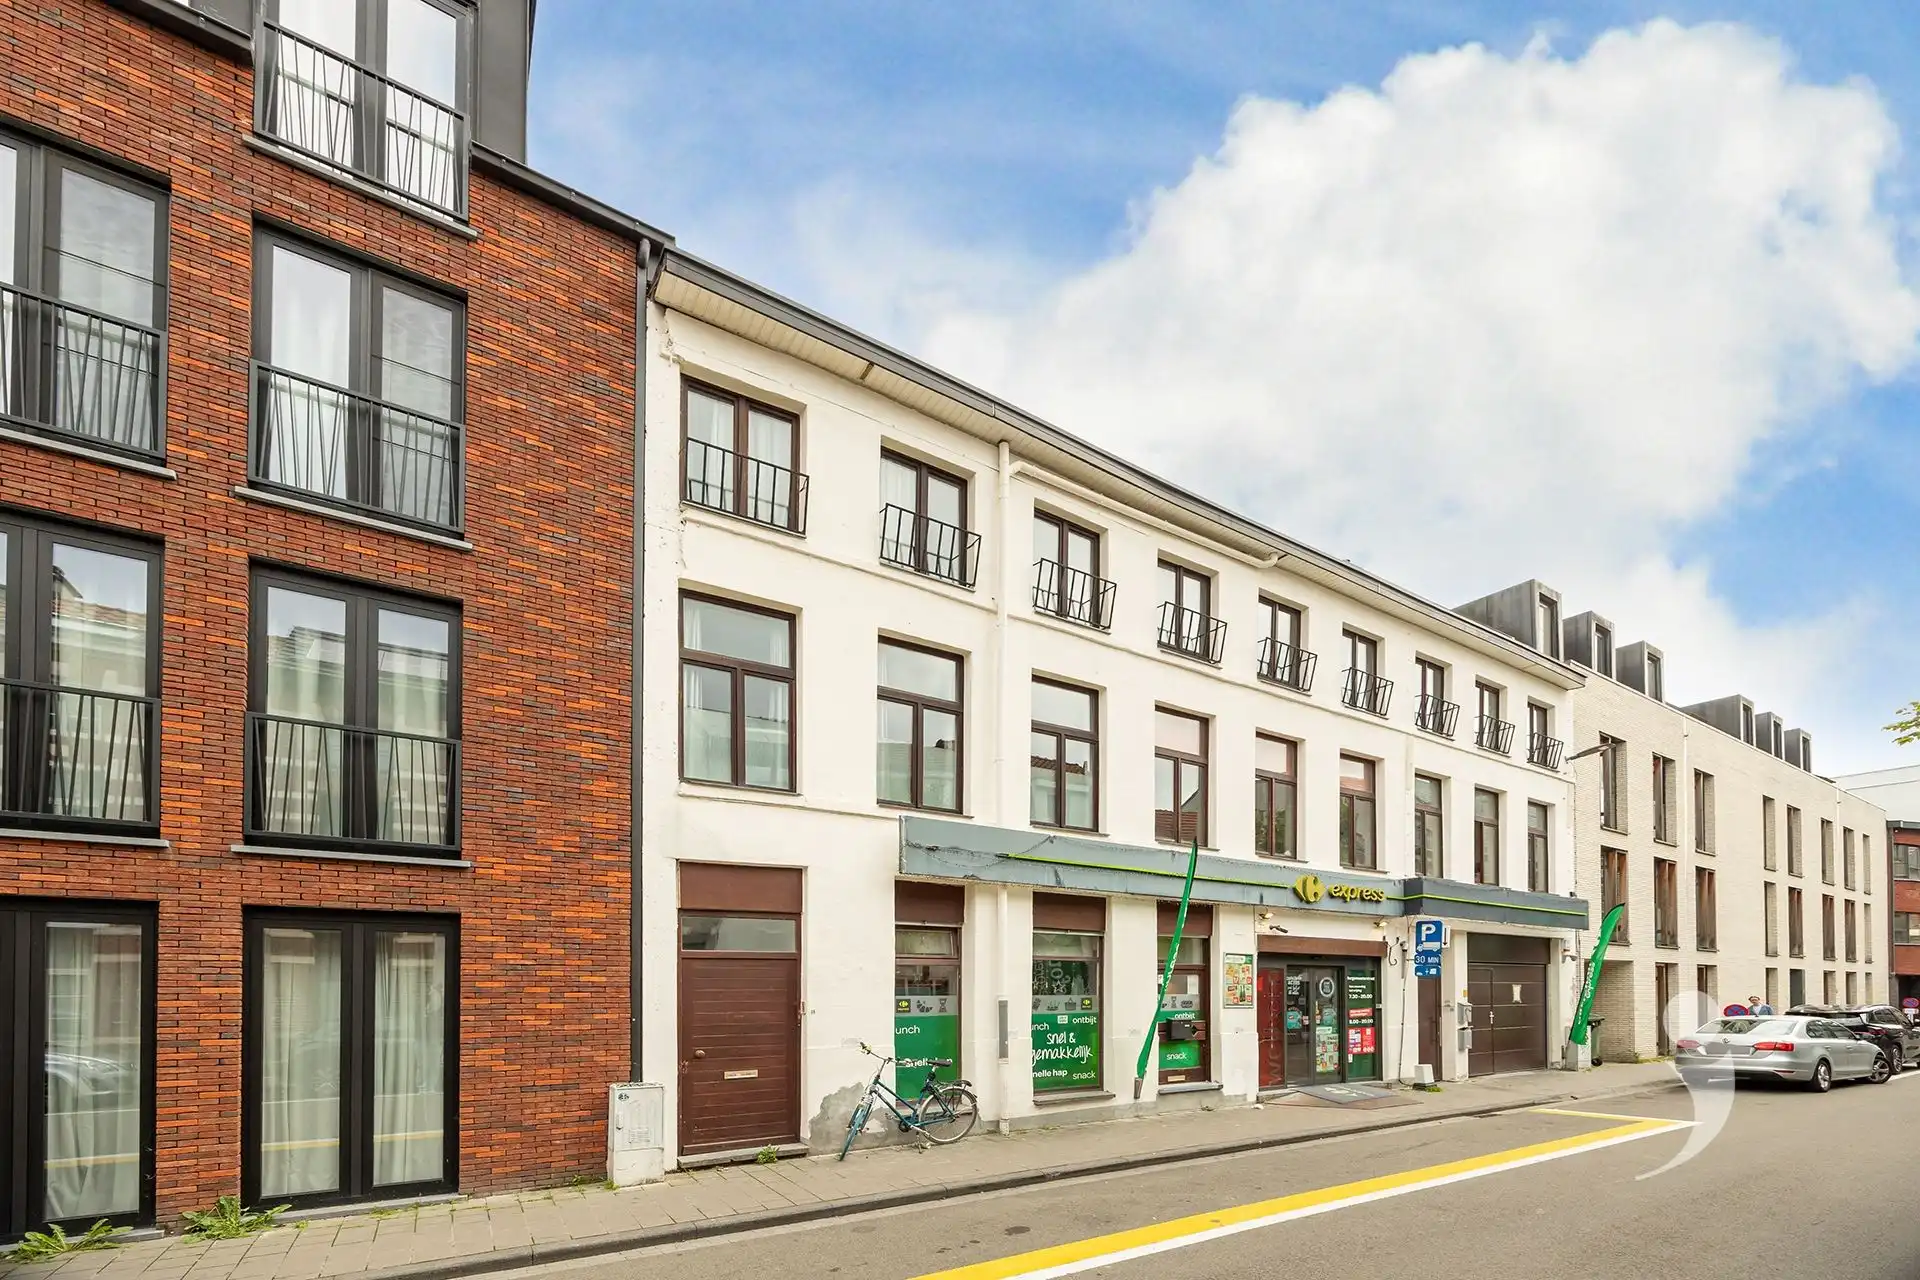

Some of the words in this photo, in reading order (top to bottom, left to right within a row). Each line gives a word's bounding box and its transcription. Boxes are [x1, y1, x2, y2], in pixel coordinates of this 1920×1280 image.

[1329, 884, 1385, 902] express
[1421, 924, 1436, 941] P
[1415, 956, 1426, 964] 30
[1072, 1016, 1097, 1025] ontbijt
[1174, 1012, 1196, 1020] ontbijt
[895, 1025, 921, 1034] unch
[1046, 1031, 1067, 1045] snel
[1069, 1032, 1076, 1043] &
[1031, 1045, 1093, 1067] gemakkelijk
[1166, 1052, 1187, 1061] snack
[1052, 1069, 1068, 1077] hap
[1072, 1070, 1096, 1080] snack
